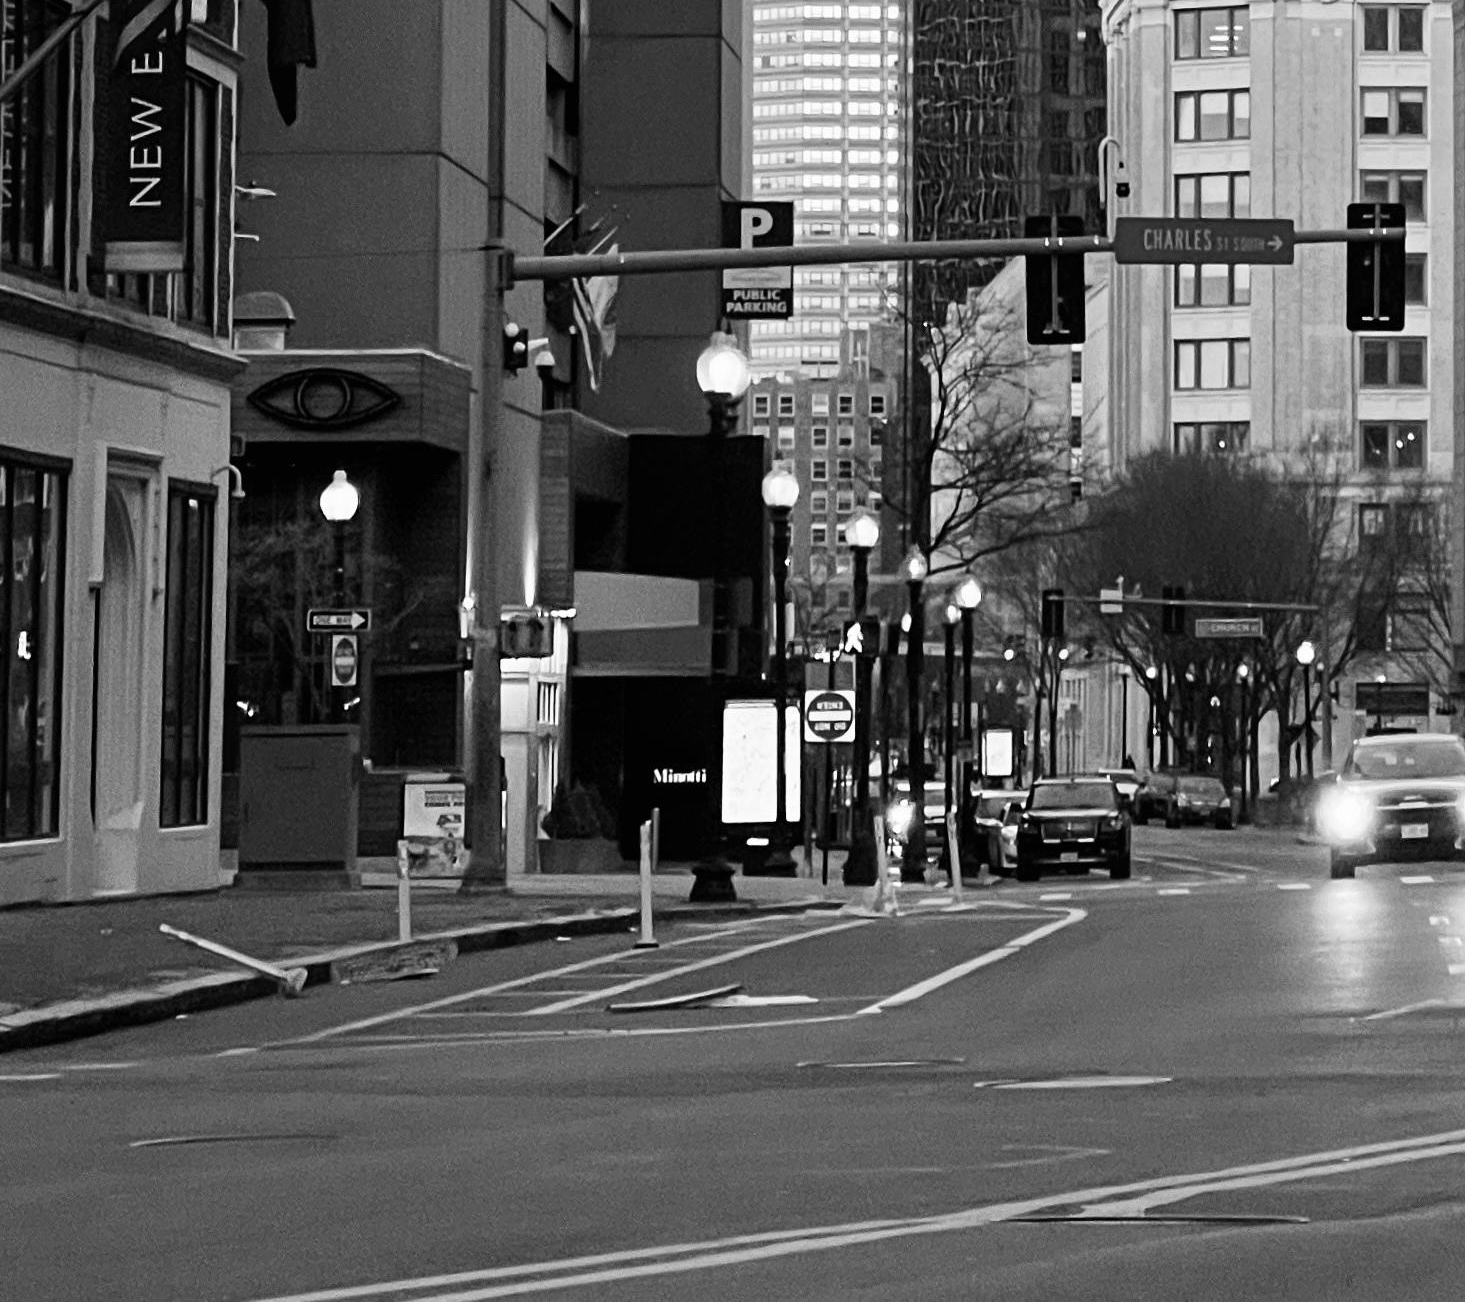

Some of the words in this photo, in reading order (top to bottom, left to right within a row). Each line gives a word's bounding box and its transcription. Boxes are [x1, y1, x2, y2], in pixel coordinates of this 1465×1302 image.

[129, 97, 162, 207] NEW
[741, 208, 773, 250] P
[1144, 229, 1212, 251] CHARLES
[733, 290, 781, 300] PUBLIC
[726, 301, 787, 313] PARKING
[653, 768, 707, 783] Minotti
